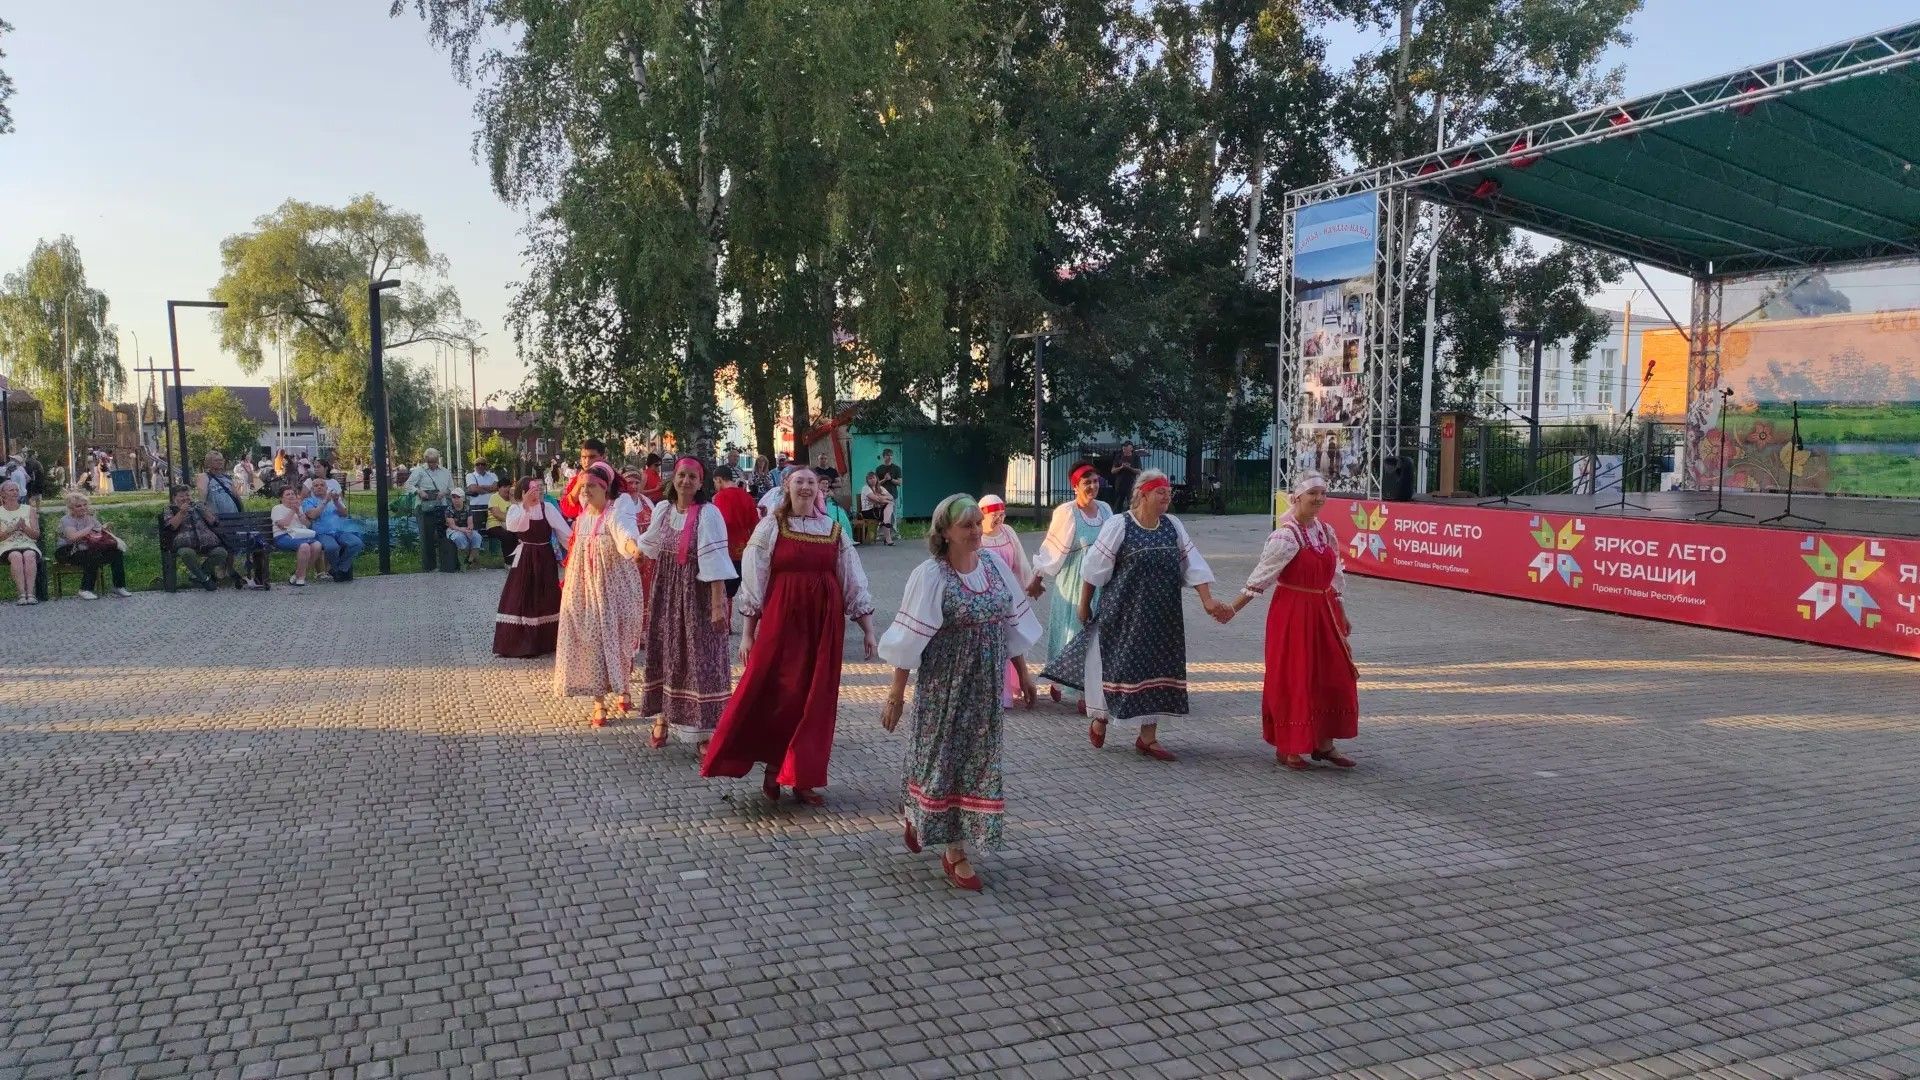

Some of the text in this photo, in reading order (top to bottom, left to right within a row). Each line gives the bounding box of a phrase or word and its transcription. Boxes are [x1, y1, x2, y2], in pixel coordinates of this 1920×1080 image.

[1394, 519, 1483, 539] ЯРКОЕ ЛЕТО
[1393, 538, 1463, 558] ЧУВАШИИ
[1594, 536, 1727, 564] ЯРКОЕ ЛЕТО
[1393, 558, 1469, 574] Проект Главы Республики
[1593, 559, 1696, 586] ЧУВАШИИ
[1899, 564, 1920, 583] Я
[1592, 583, 1706, 605] Проект Главы Республики
[1898, 593, 1920, 613] Ч
